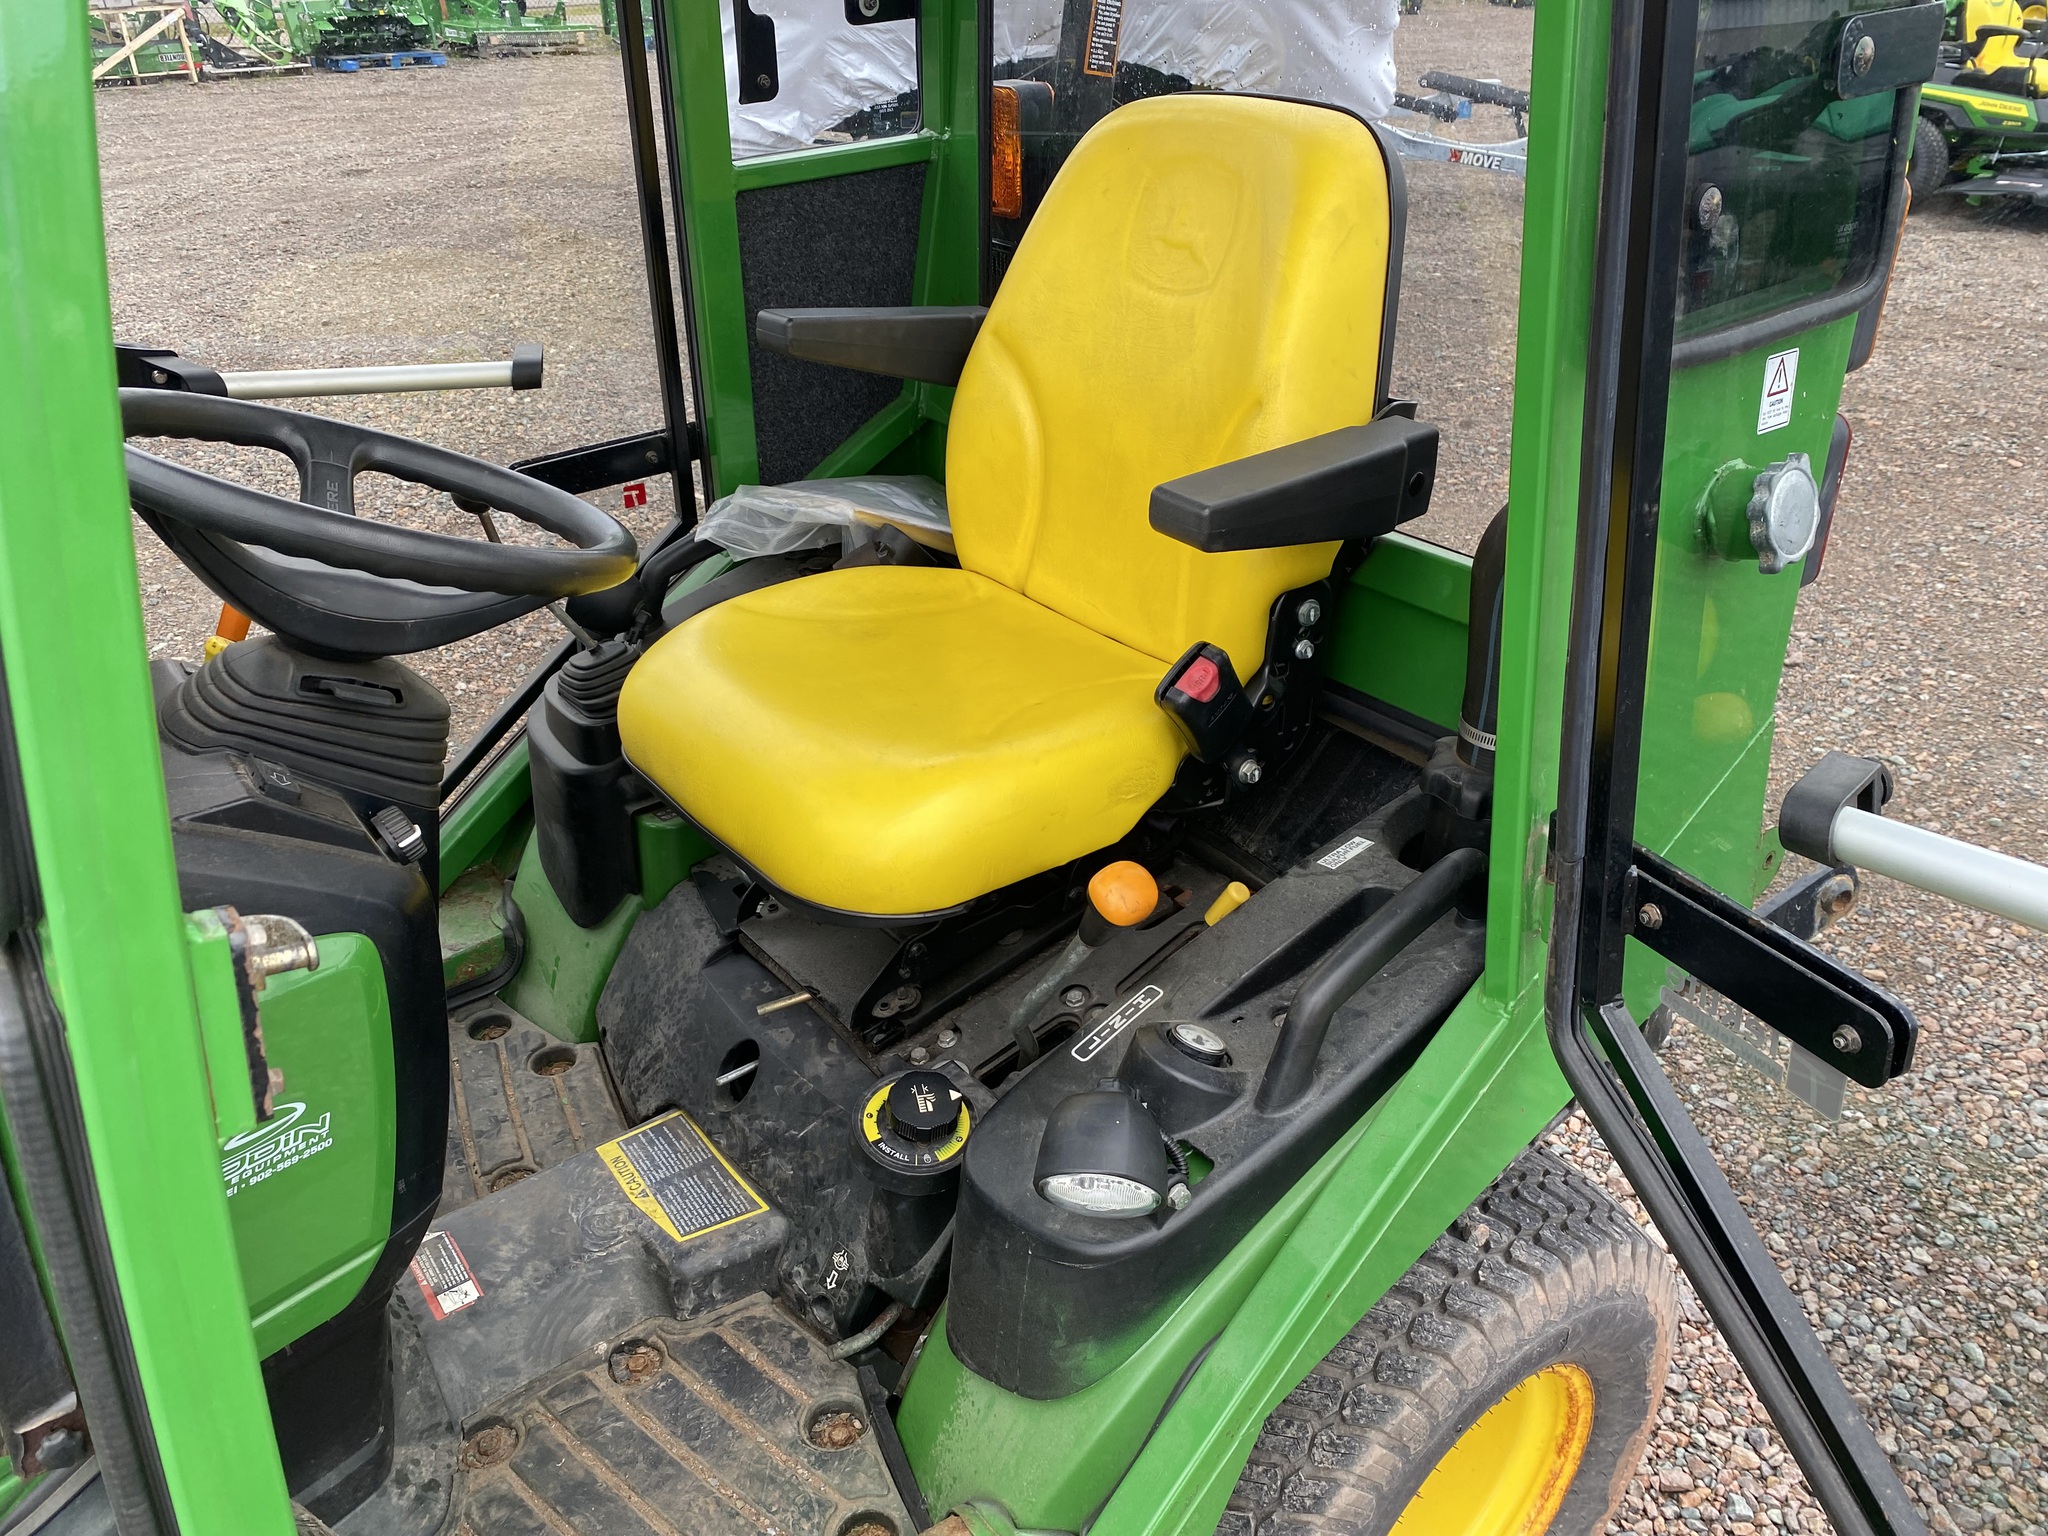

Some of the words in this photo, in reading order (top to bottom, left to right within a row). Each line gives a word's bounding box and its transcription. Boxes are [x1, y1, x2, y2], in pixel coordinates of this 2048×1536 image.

[1999, 102, 2023, 112] DEERE
[1320, 850, 1343, 864] ULTRA
[1341, 840, 1357, 851] LOW
[1349, 840, 1367, 851] FUEL
[1330, 855, 1348, 868] ONLY
[230, 1129, 330, 1185] EQUIPMENT
[249, 1137, 333, 1186] 902-569-2500
[877, 1141, 910, 1162] INSTALL
[610, 1155, 642, 1191] CAUTION
